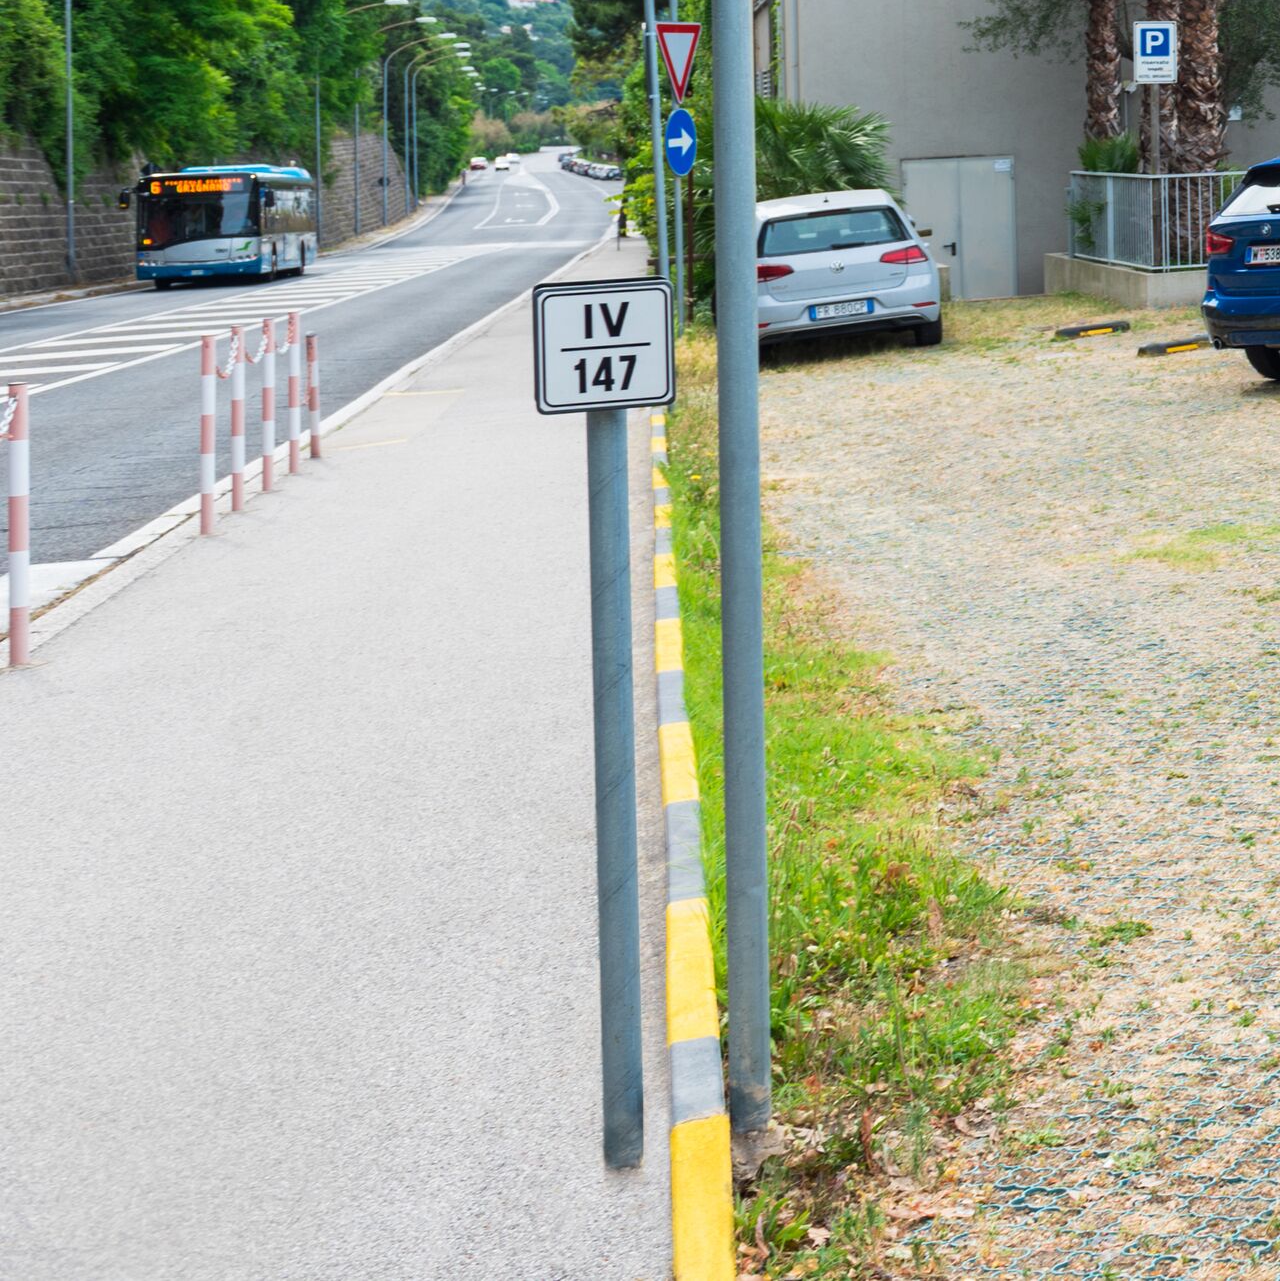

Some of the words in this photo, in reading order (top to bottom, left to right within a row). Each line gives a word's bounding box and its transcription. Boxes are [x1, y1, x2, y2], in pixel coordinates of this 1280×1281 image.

[1145, 30, 1165, 55] P
[151, 181, 162, 195] 6
[583, 301, 630, 339] IV
[573, 354, 638, 394] 147
